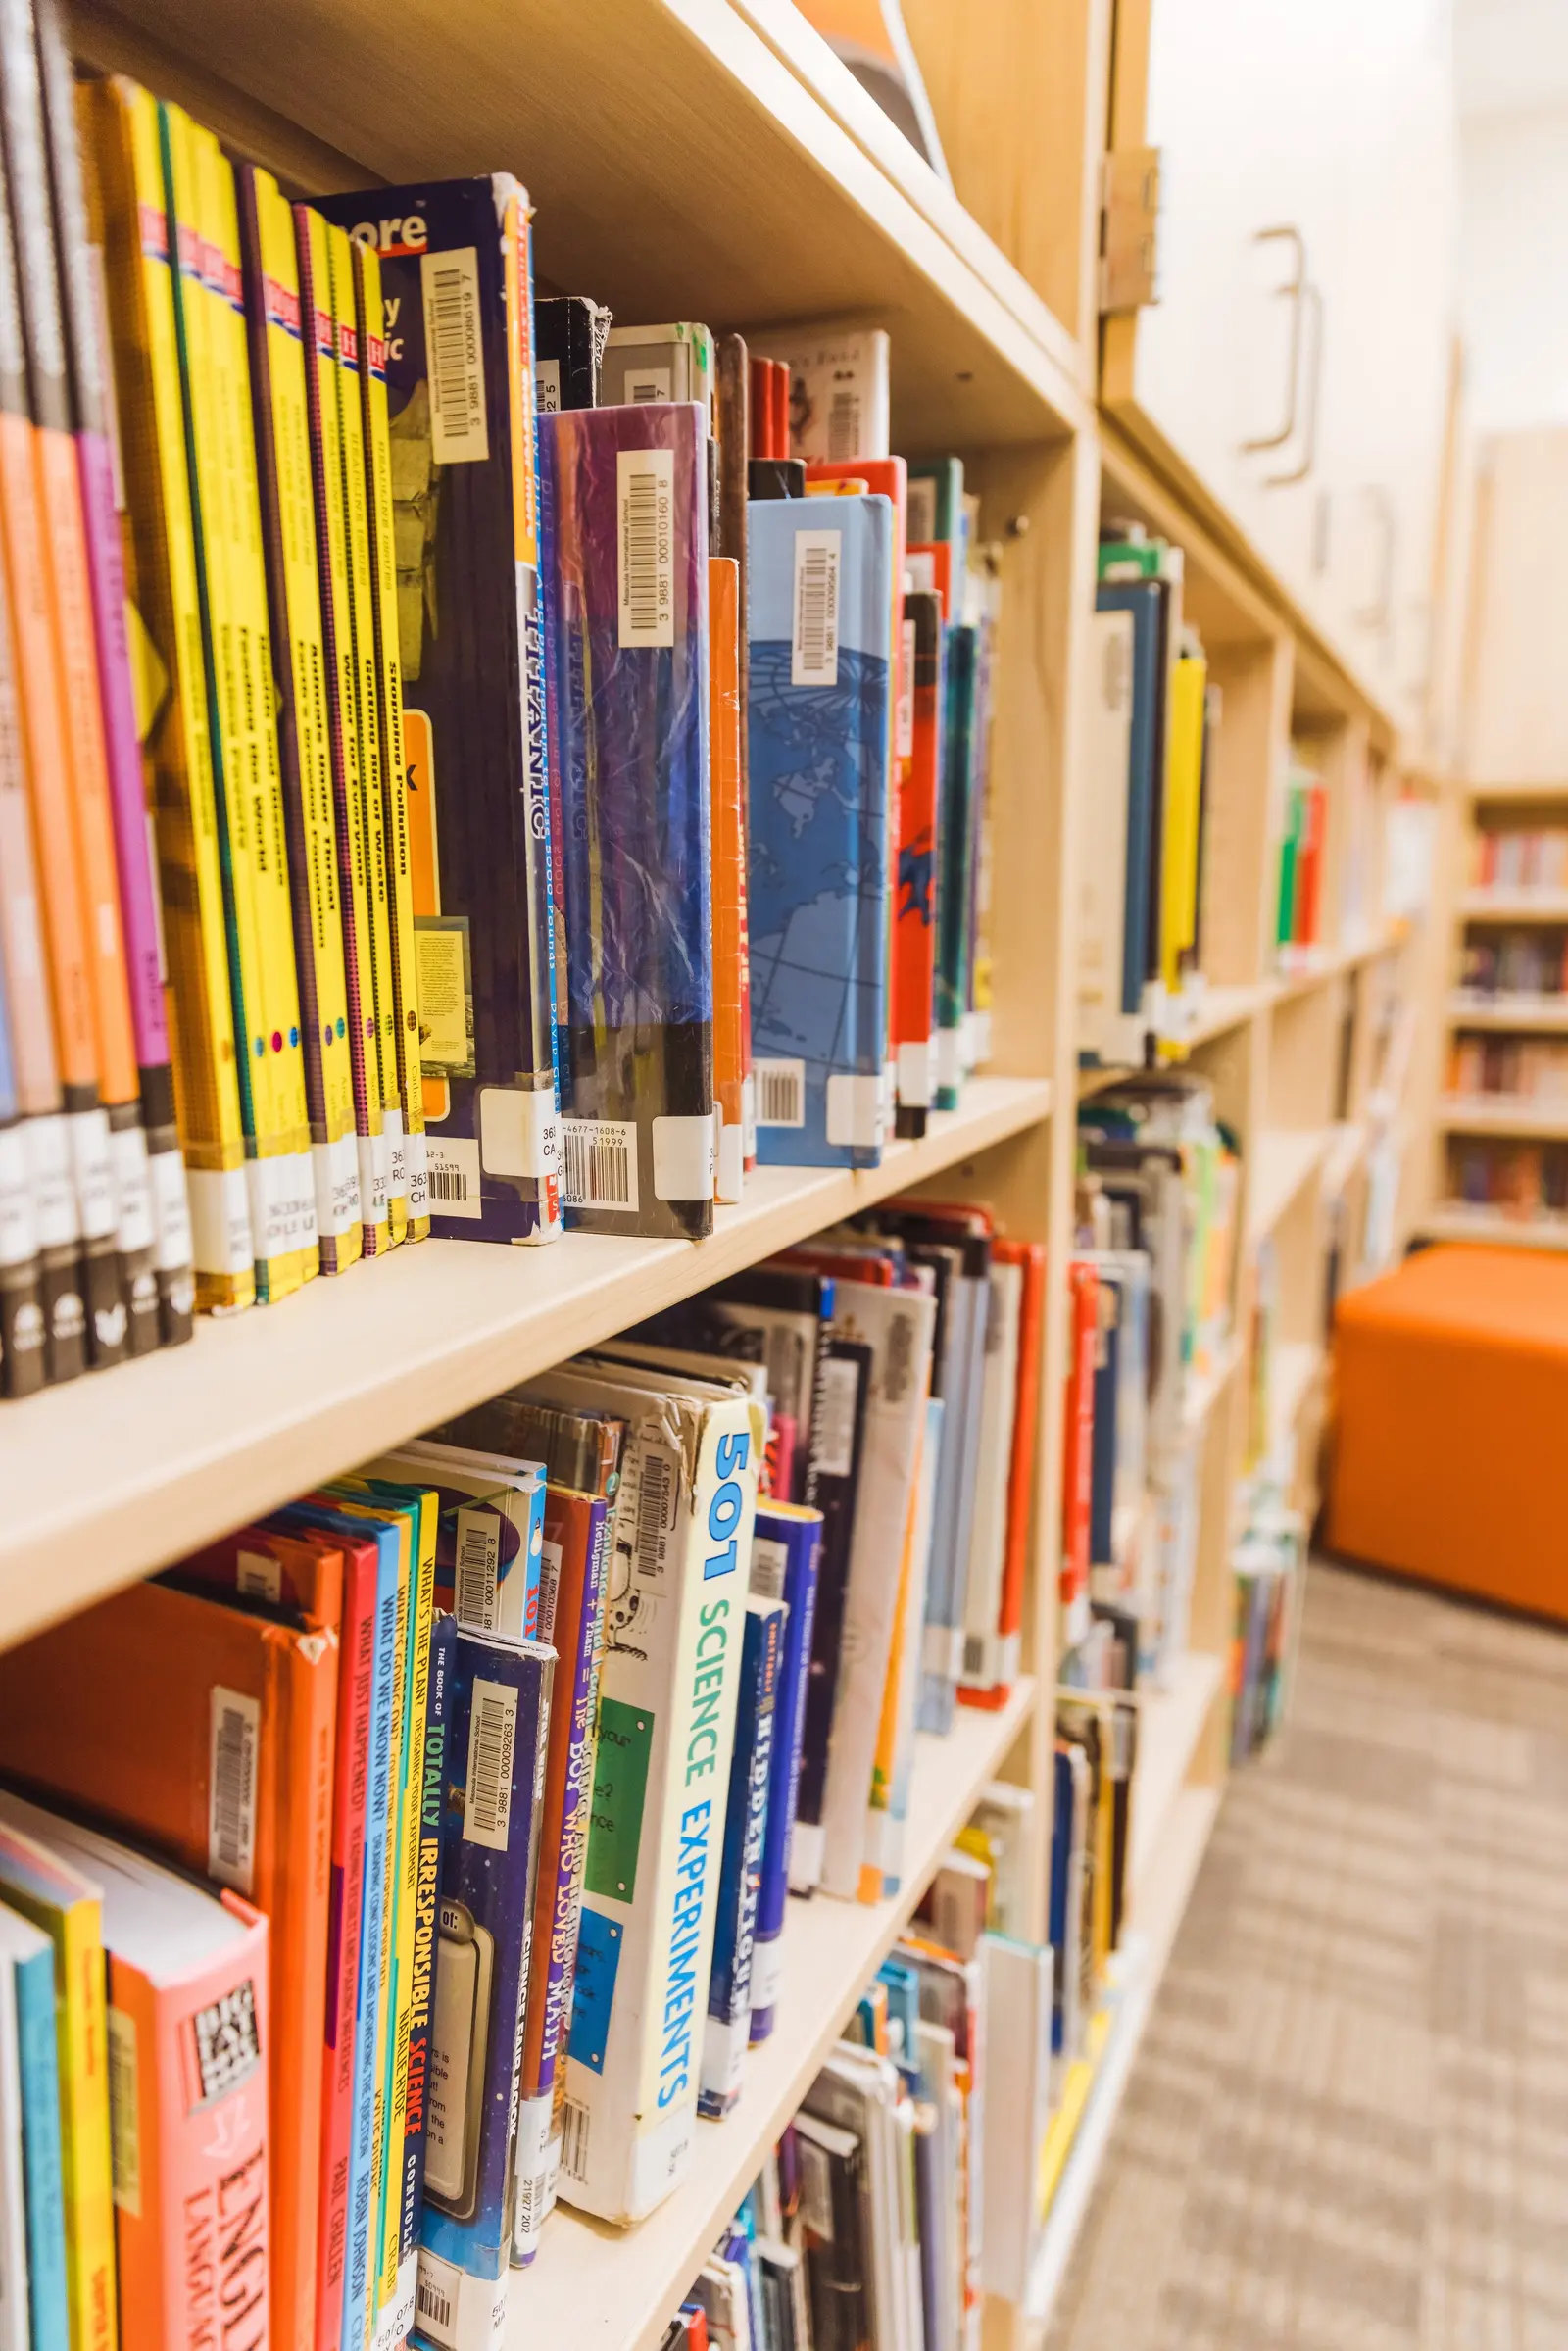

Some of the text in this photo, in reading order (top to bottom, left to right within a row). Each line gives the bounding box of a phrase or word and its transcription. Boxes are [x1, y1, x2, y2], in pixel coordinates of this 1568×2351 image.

[348, 215, 428, 254] ore
[461, 273, 481, 427] 3 9881 00008619 7
[546, 385, 556, 394] 5
[656, 388, 665, 397] 7
[659, 479, 669, 622] 3 9881 00010160 8
[522, 610, 548, 840] TITANIC
[343, 655, 354, 727] Water
[352, 779, 364, 887] Everyone
[365, 659, 385, 903] Getting Rid of Waste
[390, 661, 407, 876] Stopping Pollution
[546, 845, 555, 895] 5000
[425, 1151, 445, 1159] 12-3
[434, 1163, 460, 1172] 51599
[592, 1137, 623, 1147] 51999
[410, 1190, 426, 1203] CH
[661, 1477, 671, 1529] 00007543
[484, 1537, 496, 1606] 00011292 8
[658, 1535, 667, 1560] 9881
[418, 1556, 436, 1620] WHAT'S
[525, 1584, 538, 1638] 101
[545, 1578, 558, 1631] 00010368
[380, 1594, 395, 1645] WHAT
[417, 1621, 431, 1656] THE
[379, 1650, 393, 1676] DO
[436, 1647, 447, 1666] THE
[377, 1680, 392, 1712] WE
[414, 1658, 429, 1708] PLAN?
[433, 1701, 443, 1716] OF
[434, 1669, 446, 1700] BOOK
[373, 1711, 389, 1768] KNOW
[411, 1717, 423, 1782] DESIGNING
[471, 1739, 480, 1776] International
[500, 1723, 514, 1779] 00009263
[421, 1723, 446, 1827] TOTALLY
[657, 1432, 751, 2111] 501 SCIENCE EXPERIMENTS
[371, 1772, 388, 1823] NOW?
[410, 1783, 420, 1815] YOUR
[498, 1786, 509, 1814] 9881
[497, 1819, 506, 1828] 3
[406, 1816, 419, 1890] EXPERIMENT
[409, 1837, 440, 2032] IRRESPONSIBLE
[552, 1886, 570, 1964] LOVED
[396, 2007, 411, 2077] NATALIE
[508, 1919, 532, 2139] SCIENCE FAIR BOOK
[542, 1981, 564, 2060] MATH
[442, 2051, 450, 2064] is
[394, 2073, 407, 2122] HYDE
[403, 2036, 428, 2137] SCIENCE
[428, 2097, 446, 2112] rom
[431, 2113, 445, 2130] the
[354, 2170, 370, 2227] ROBIN
[520, 2179, 534, 2233] 21927 202
[351, 2225, 368, 2303] JOHNSON
